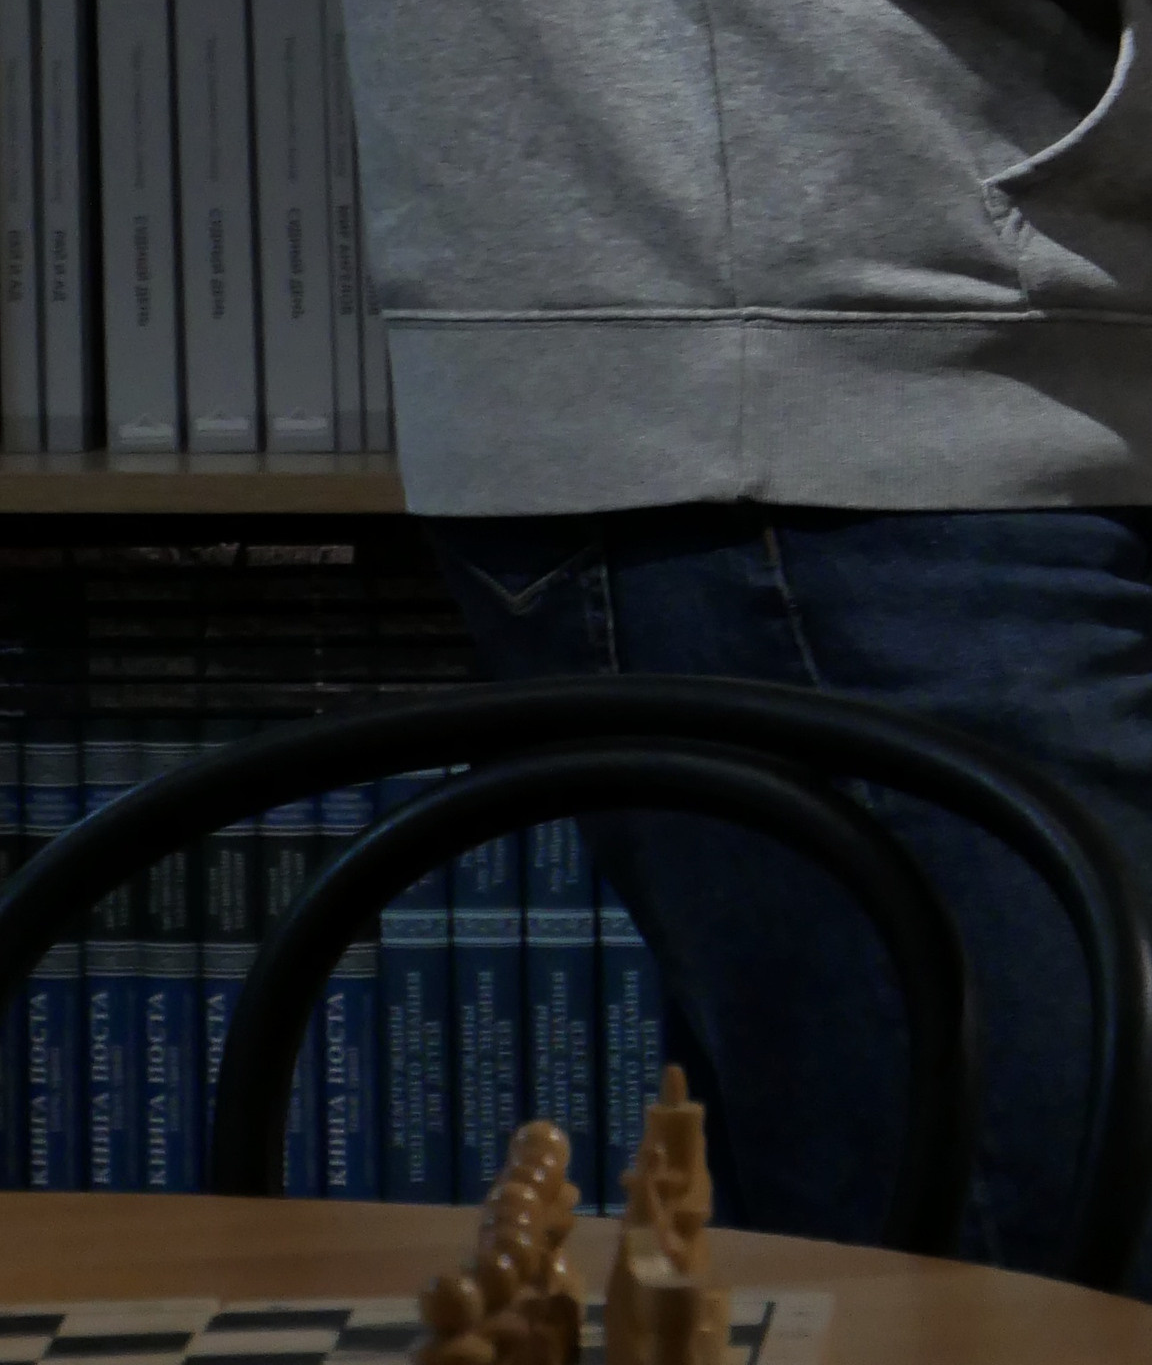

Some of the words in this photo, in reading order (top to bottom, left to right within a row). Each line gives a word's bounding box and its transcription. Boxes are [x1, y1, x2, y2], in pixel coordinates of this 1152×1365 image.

[28, 992, 48, 1085] ПОСТА
[90, 990, 110, 1082] ПОСТА
[146, 991, 166, 1084] ПОСТА
[326, 992, 346, 1085] ПОСТА
[424, 1020, 442, 1086] ДЕТЕЙ
[497, 1019, 514, 1085] ДЕТЕЙ
[533, 1004, 549, 1118] МЧУЖИНЫ
[569, 1020, 587, 1085] ДЕТЕЙ
[30, 1095, 49, 1186] КНИГА
[91, 1092, 111, 1185] КНИГА
[147, 1095, 167, 1186] КНИГА
[327, 1095, 347, 1187] КНИГА
